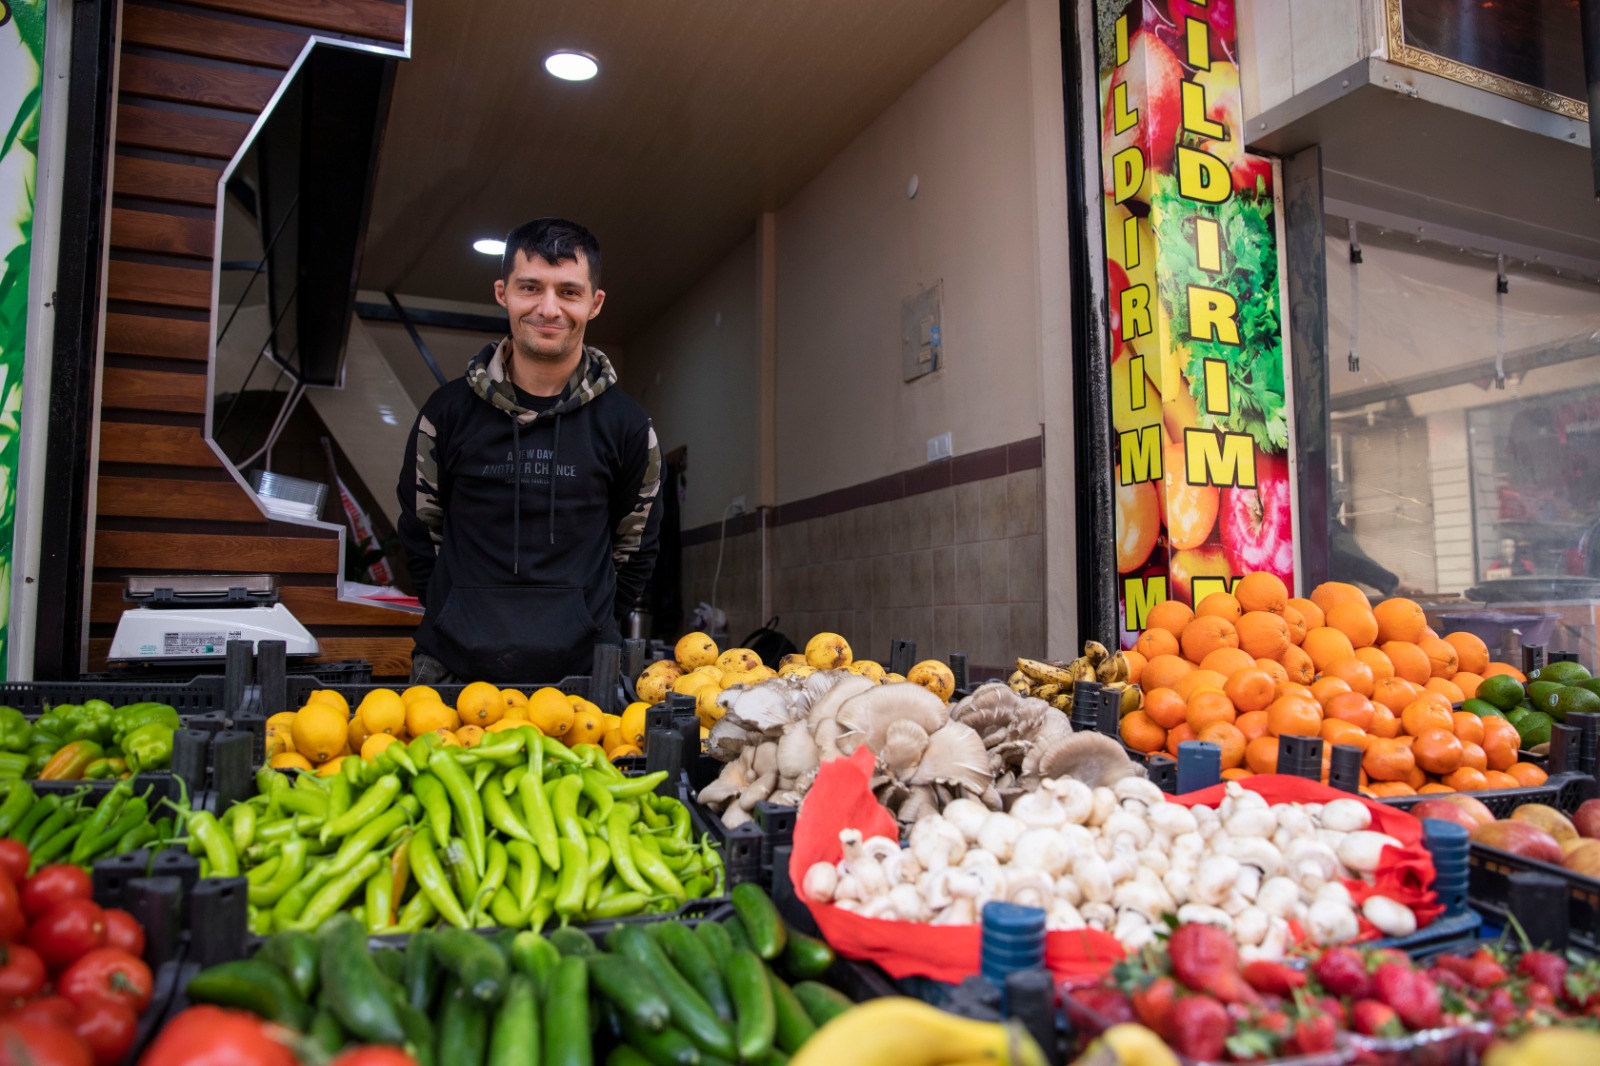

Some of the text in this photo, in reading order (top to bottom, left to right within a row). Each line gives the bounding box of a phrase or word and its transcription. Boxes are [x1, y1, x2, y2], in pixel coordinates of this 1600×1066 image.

[1177, 0, 1258, 490] ILDIRIM
[507, 451, 513, 461] A
[536, 449, 554, 460] DAY
[534, 462, 577, 477] CHNCE
